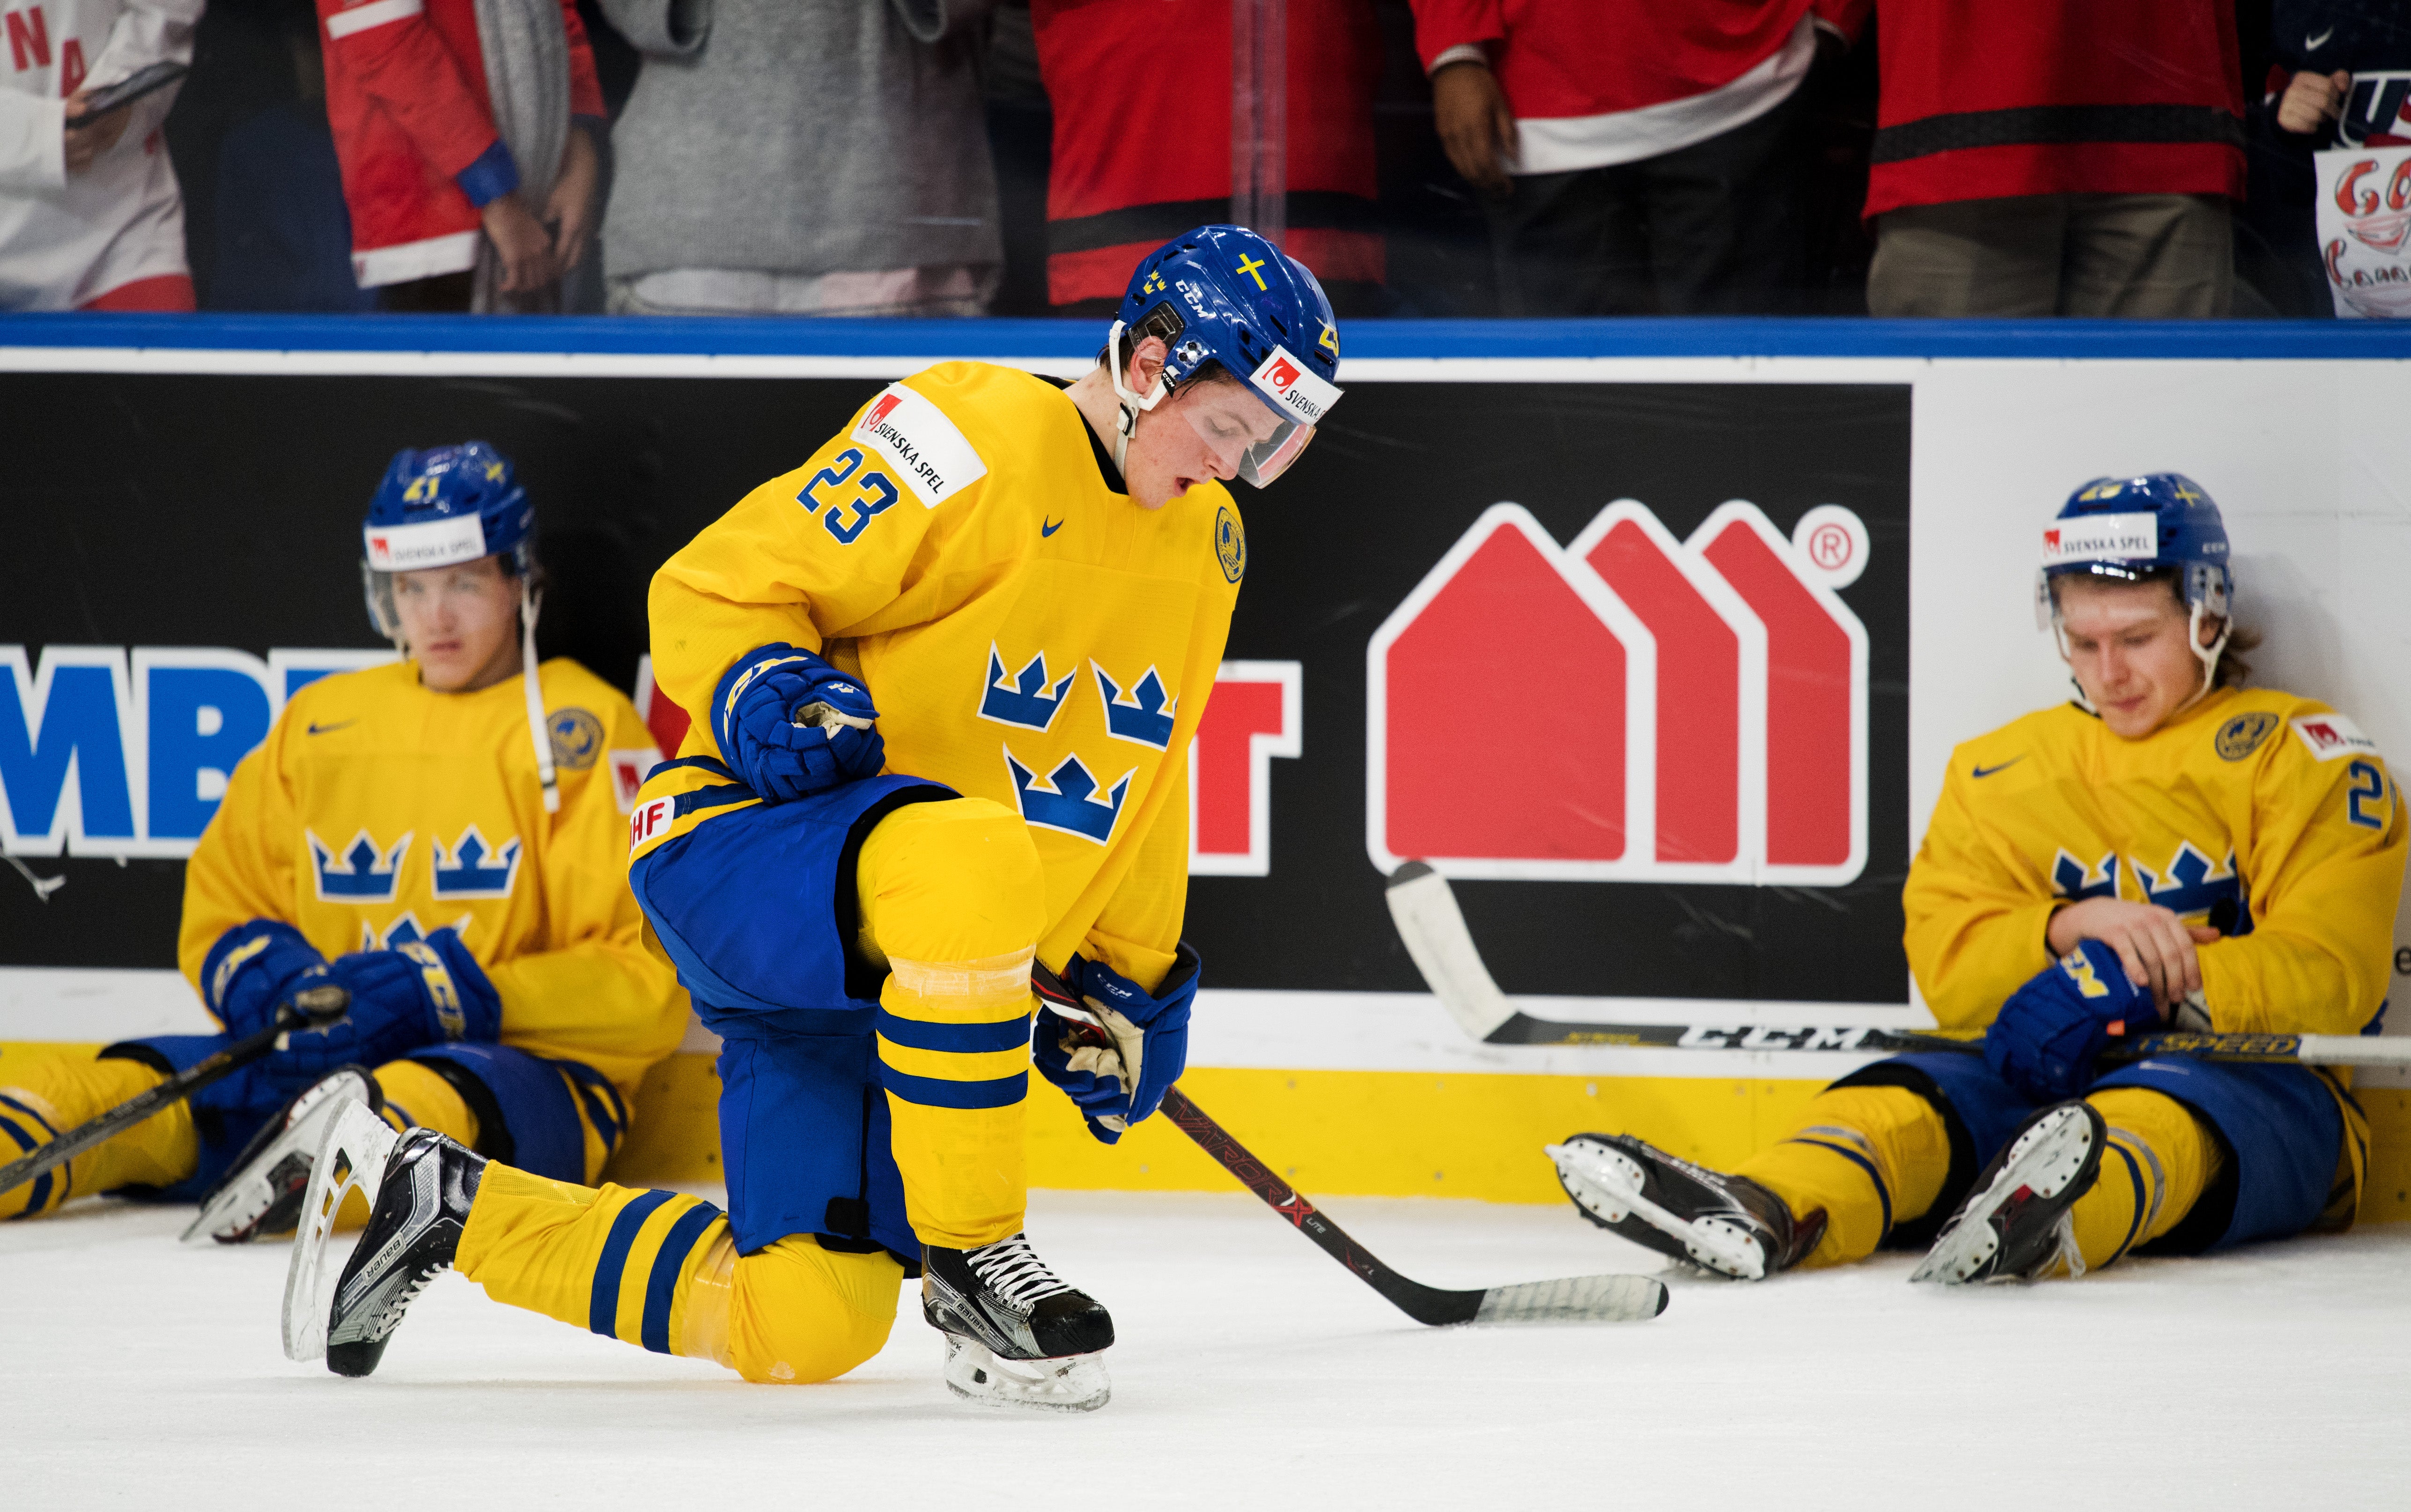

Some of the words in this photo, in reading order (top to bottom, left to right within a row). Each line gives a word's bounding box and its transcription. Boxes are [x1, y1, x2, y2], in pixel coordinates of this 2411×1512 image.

[0, 6, 89, 100] NA
[1175, 279, 1209, 318] CCM
[1162, 372, 1175, 388] CCM
[1285, 390, 1321, 418] SVENSKA
[874, 423, 919, 465] SVENSKA
[915, 462, 944, 494] SPEL
[795, 447, 900, 546] 23
[1678, 1024, 1871, 1050] CCM
[1306, 1217, 1327, 1234] LITE
[367, 1239, 401, 1278] BAUER
[957, 1303, 986, 1332] BAUER
